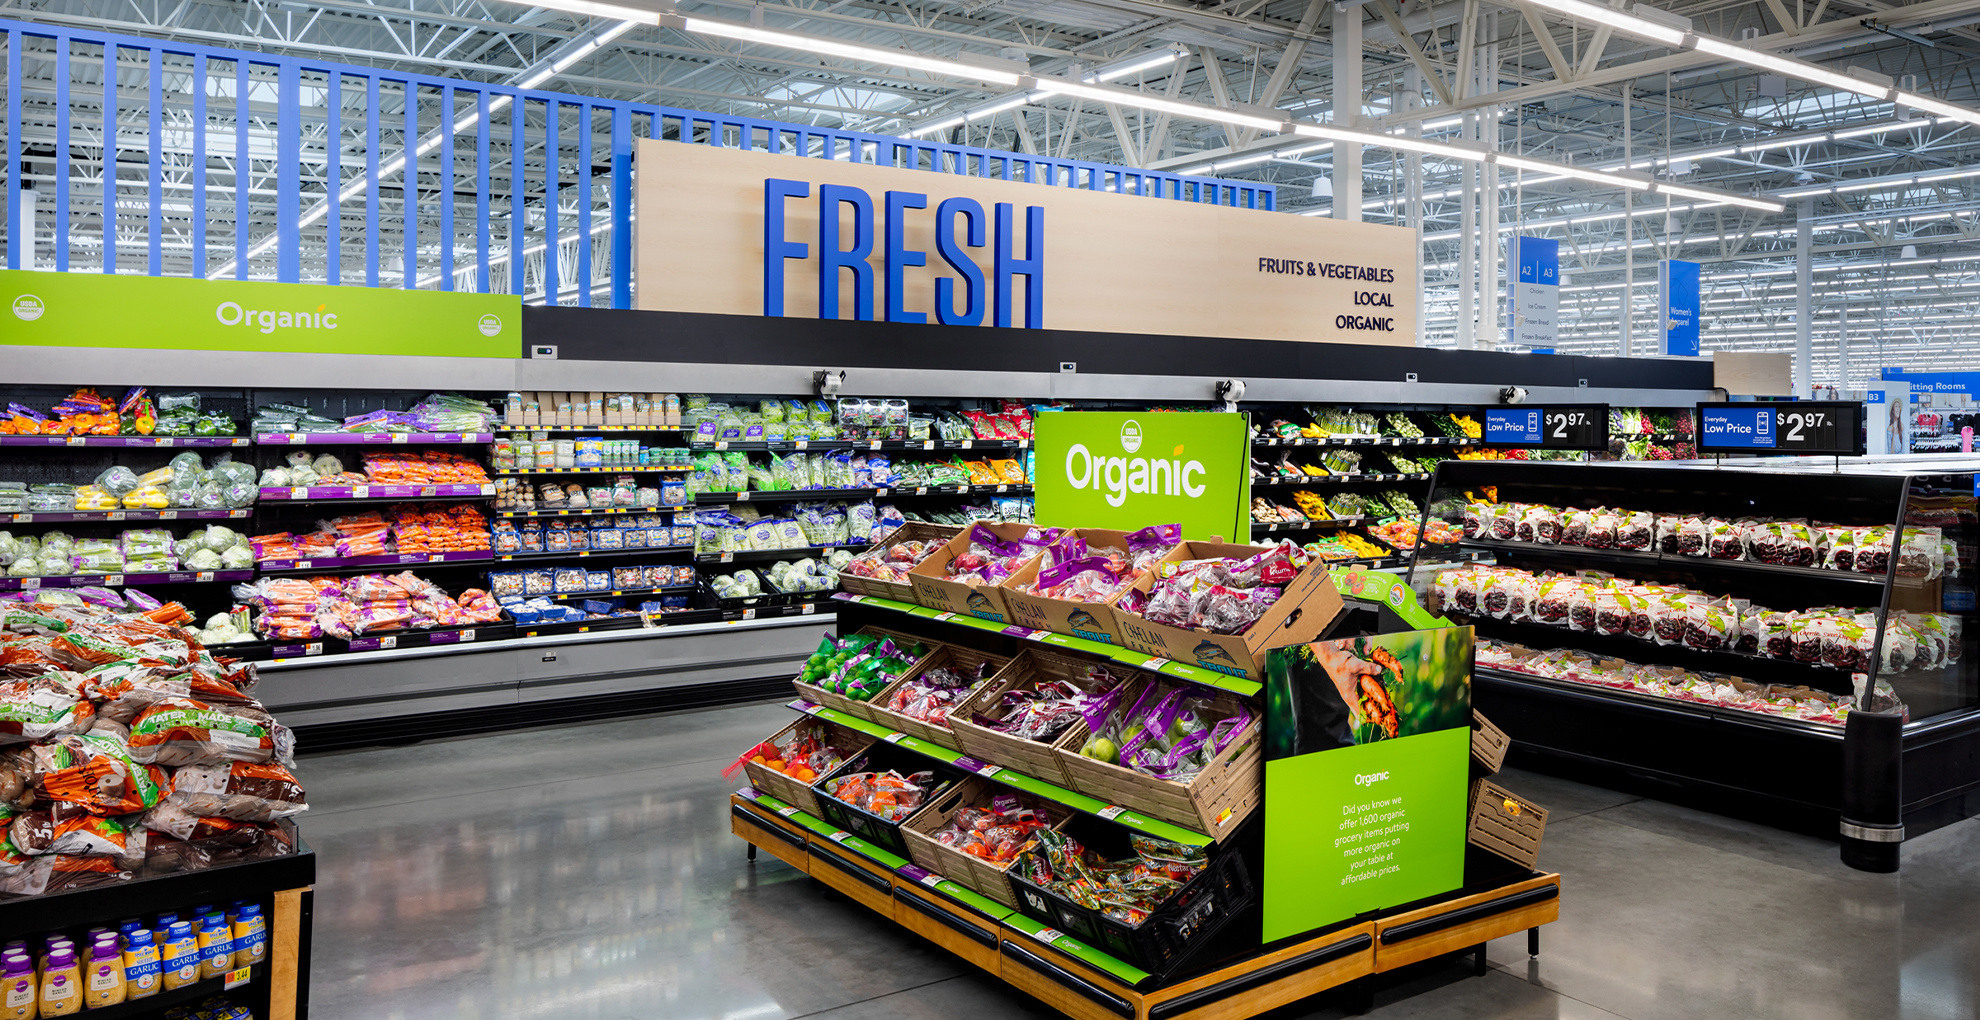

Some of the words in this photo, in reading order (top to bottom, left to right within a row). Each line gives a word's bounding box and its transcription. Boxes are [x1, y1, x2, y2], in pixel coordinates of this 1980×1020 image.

[764, 178, 1044, 329] FRESH
[1259, 257, 1304, 276] FRUITS
[1307, 262, 1316, 276] &
[1318, 262, 1394, 283] VEGETABLES
[1521, 265, 1532, 276] A2
[1543, 268, 1553, 278] A3
[1529, 287, 1545, 295] Chicken
[1354, 291, 1394, 307] LOCAL
[216, 301, 338, 334] Organic
[1670, 307, 1692, 317] Women's
[1336, 315, 1394, 332] ORGANIC
[1538, 318, 1550, 326] Bread
[1910, 383, 1934, 392] itting
[1935, 382, 1966, 390] Rooms
[1868, 393, 1879, 401] B3
[1125, 428, 1138, 436] USDA
[1487, 423, 1503, 432] Low
[1504, 423, 1525, 432] Price
[1704, 423, 1726, 433] Low
[1726, 423, 1752, 434] Price
[1124, 436, 1140, 444] ORGANIC
[1066, 443, 1206, 508] Organic
[976, 528, 994, 540] Organic
[1042, 568, 1059, 578] Organic
[918, 582, 950, 602] CHELAN
[1253, 588, 1276, 599] Organic
[970, 609, 1004, 623] TROUT
[1010, 598, 1047, 621] CHELAN
[1071, 628, 1112, 644] TROUT
[1122, 621, 1168, 649] CHELAN
[1174, 665, 1195, 675] Organic
[1197, 660, 1248, 680] TROUT
[12, 704, 50, 717] MADE
[1148, 709, 1162, 725] Organic
[149, 711, 186, 724] TATER
[198, 711, 233, 724] MADE
[903, 739, 918, 747] Organic
[1217, 733, 1235, 748] Organic
[1002, 773, 1019, 783] Organic
[1354, 768, 1390, 787] Organic
[994, 796, 1017, 808] Organic
[1343, 804, 1356, 815] Did
[1357, 804, 1370, 815] you
[1371, 800, 1390, 809] know
[1392, 796, 1402, 804] we
[1122, 814, 1144, 826] Organic
[1339, 819, 1358, 830] offer
[1359, 813, 1378, 826] 1,600
[1379, 808, 1405, 822] organic
[1335, 834, 1362, 848] grocery
[1364, 828, 1383, 839] items
[1384, 822, 1410, 836] putting
[1343, 846, 1363, 857] more
[1364, 839, 1390, 853] organic
[1391, 837, 1401, 846] on
[1350, 859, 1366, 872] your
[1367, 854, 1385, 866] table
[1386, 852, 1394, 860] at
[1341, 869, 1378, 886] affordable
[1379, 864, 1401, 878] prices.
[944, 883, 961, 894] Organic
[205, 942, 233, 956] GARLIC
[1061, 939, 1082, 951] Organic
[171, 953, 200, 968] GARLIC
[130, 962, 159, 976] GARLIC
[236, 969, 248, 981] 3.44
